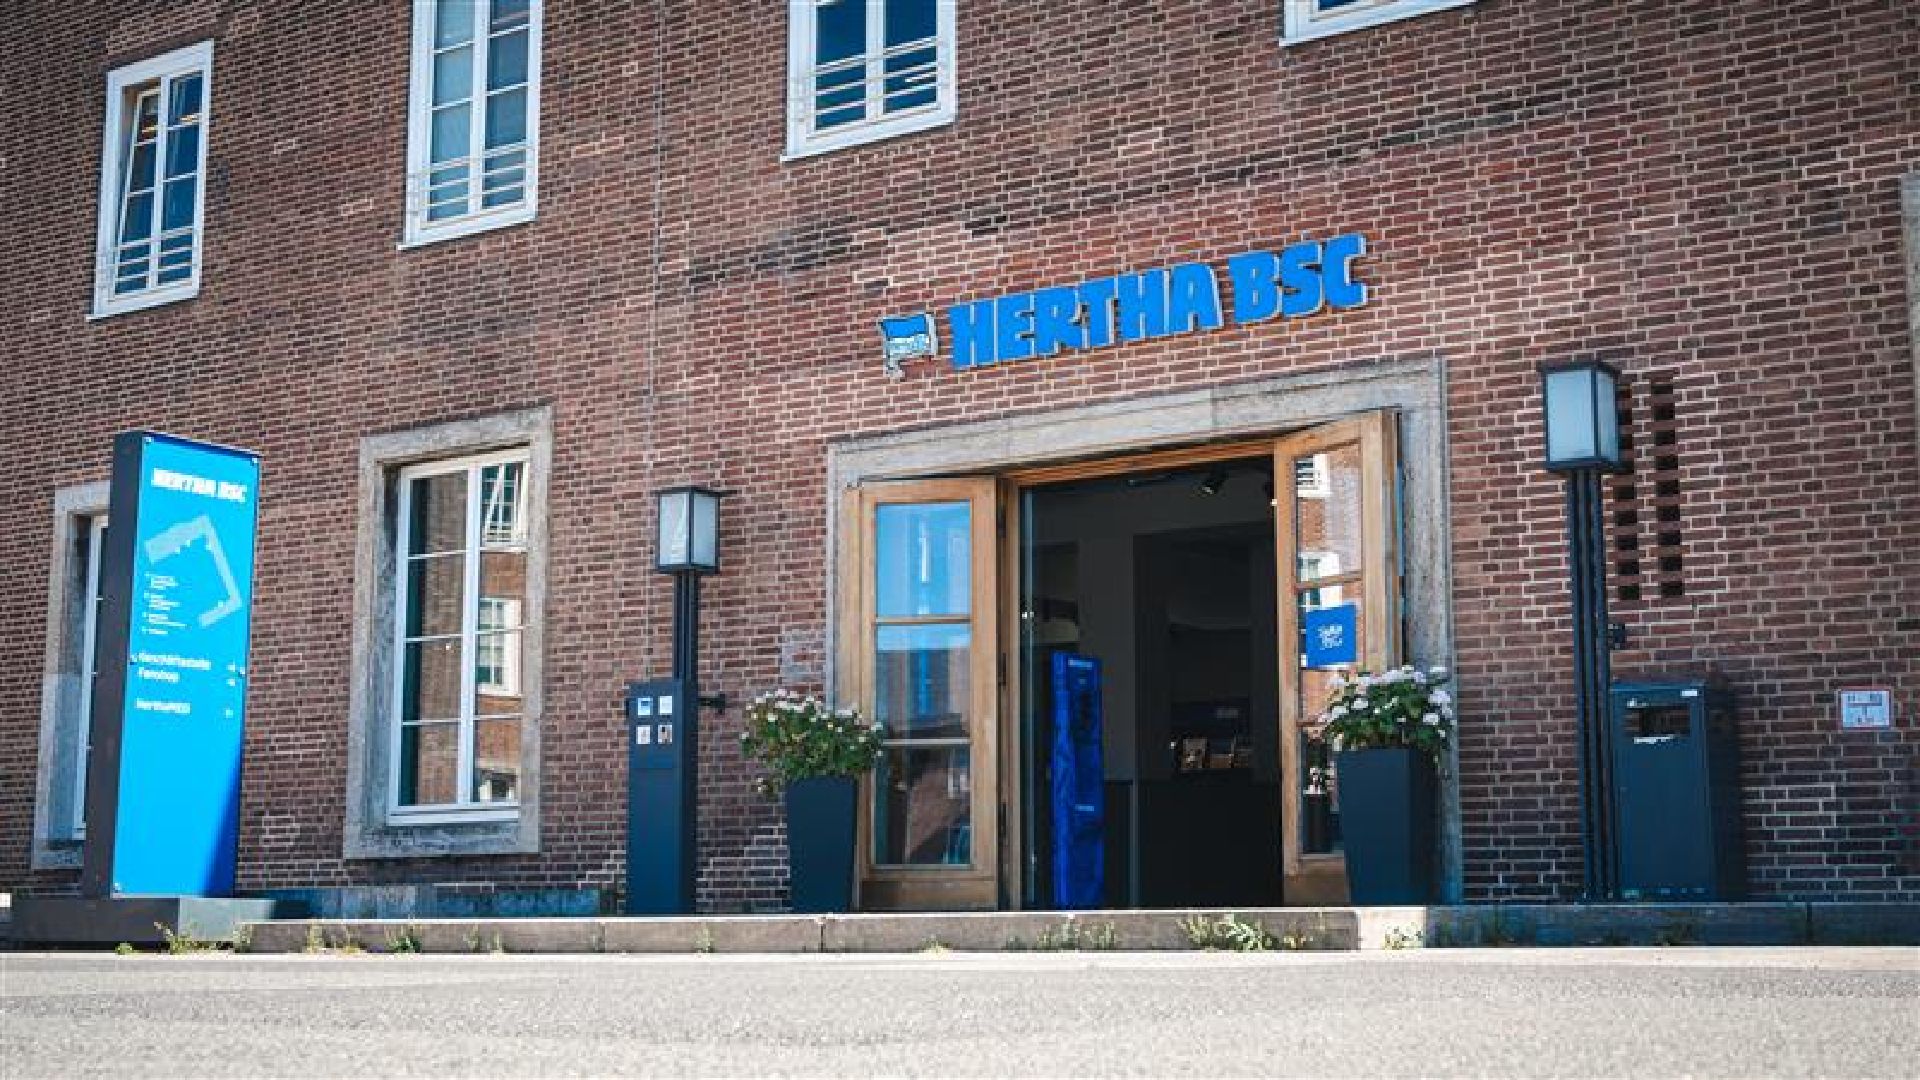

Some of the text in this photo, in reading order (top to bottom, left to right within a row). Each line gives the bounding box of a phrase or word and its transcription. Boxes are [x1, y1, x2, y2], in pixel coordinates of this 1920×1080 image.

[948, 232, 1368, 370] HERTHA BSC
[152, 467, 248, 503] HERTHA BSC
